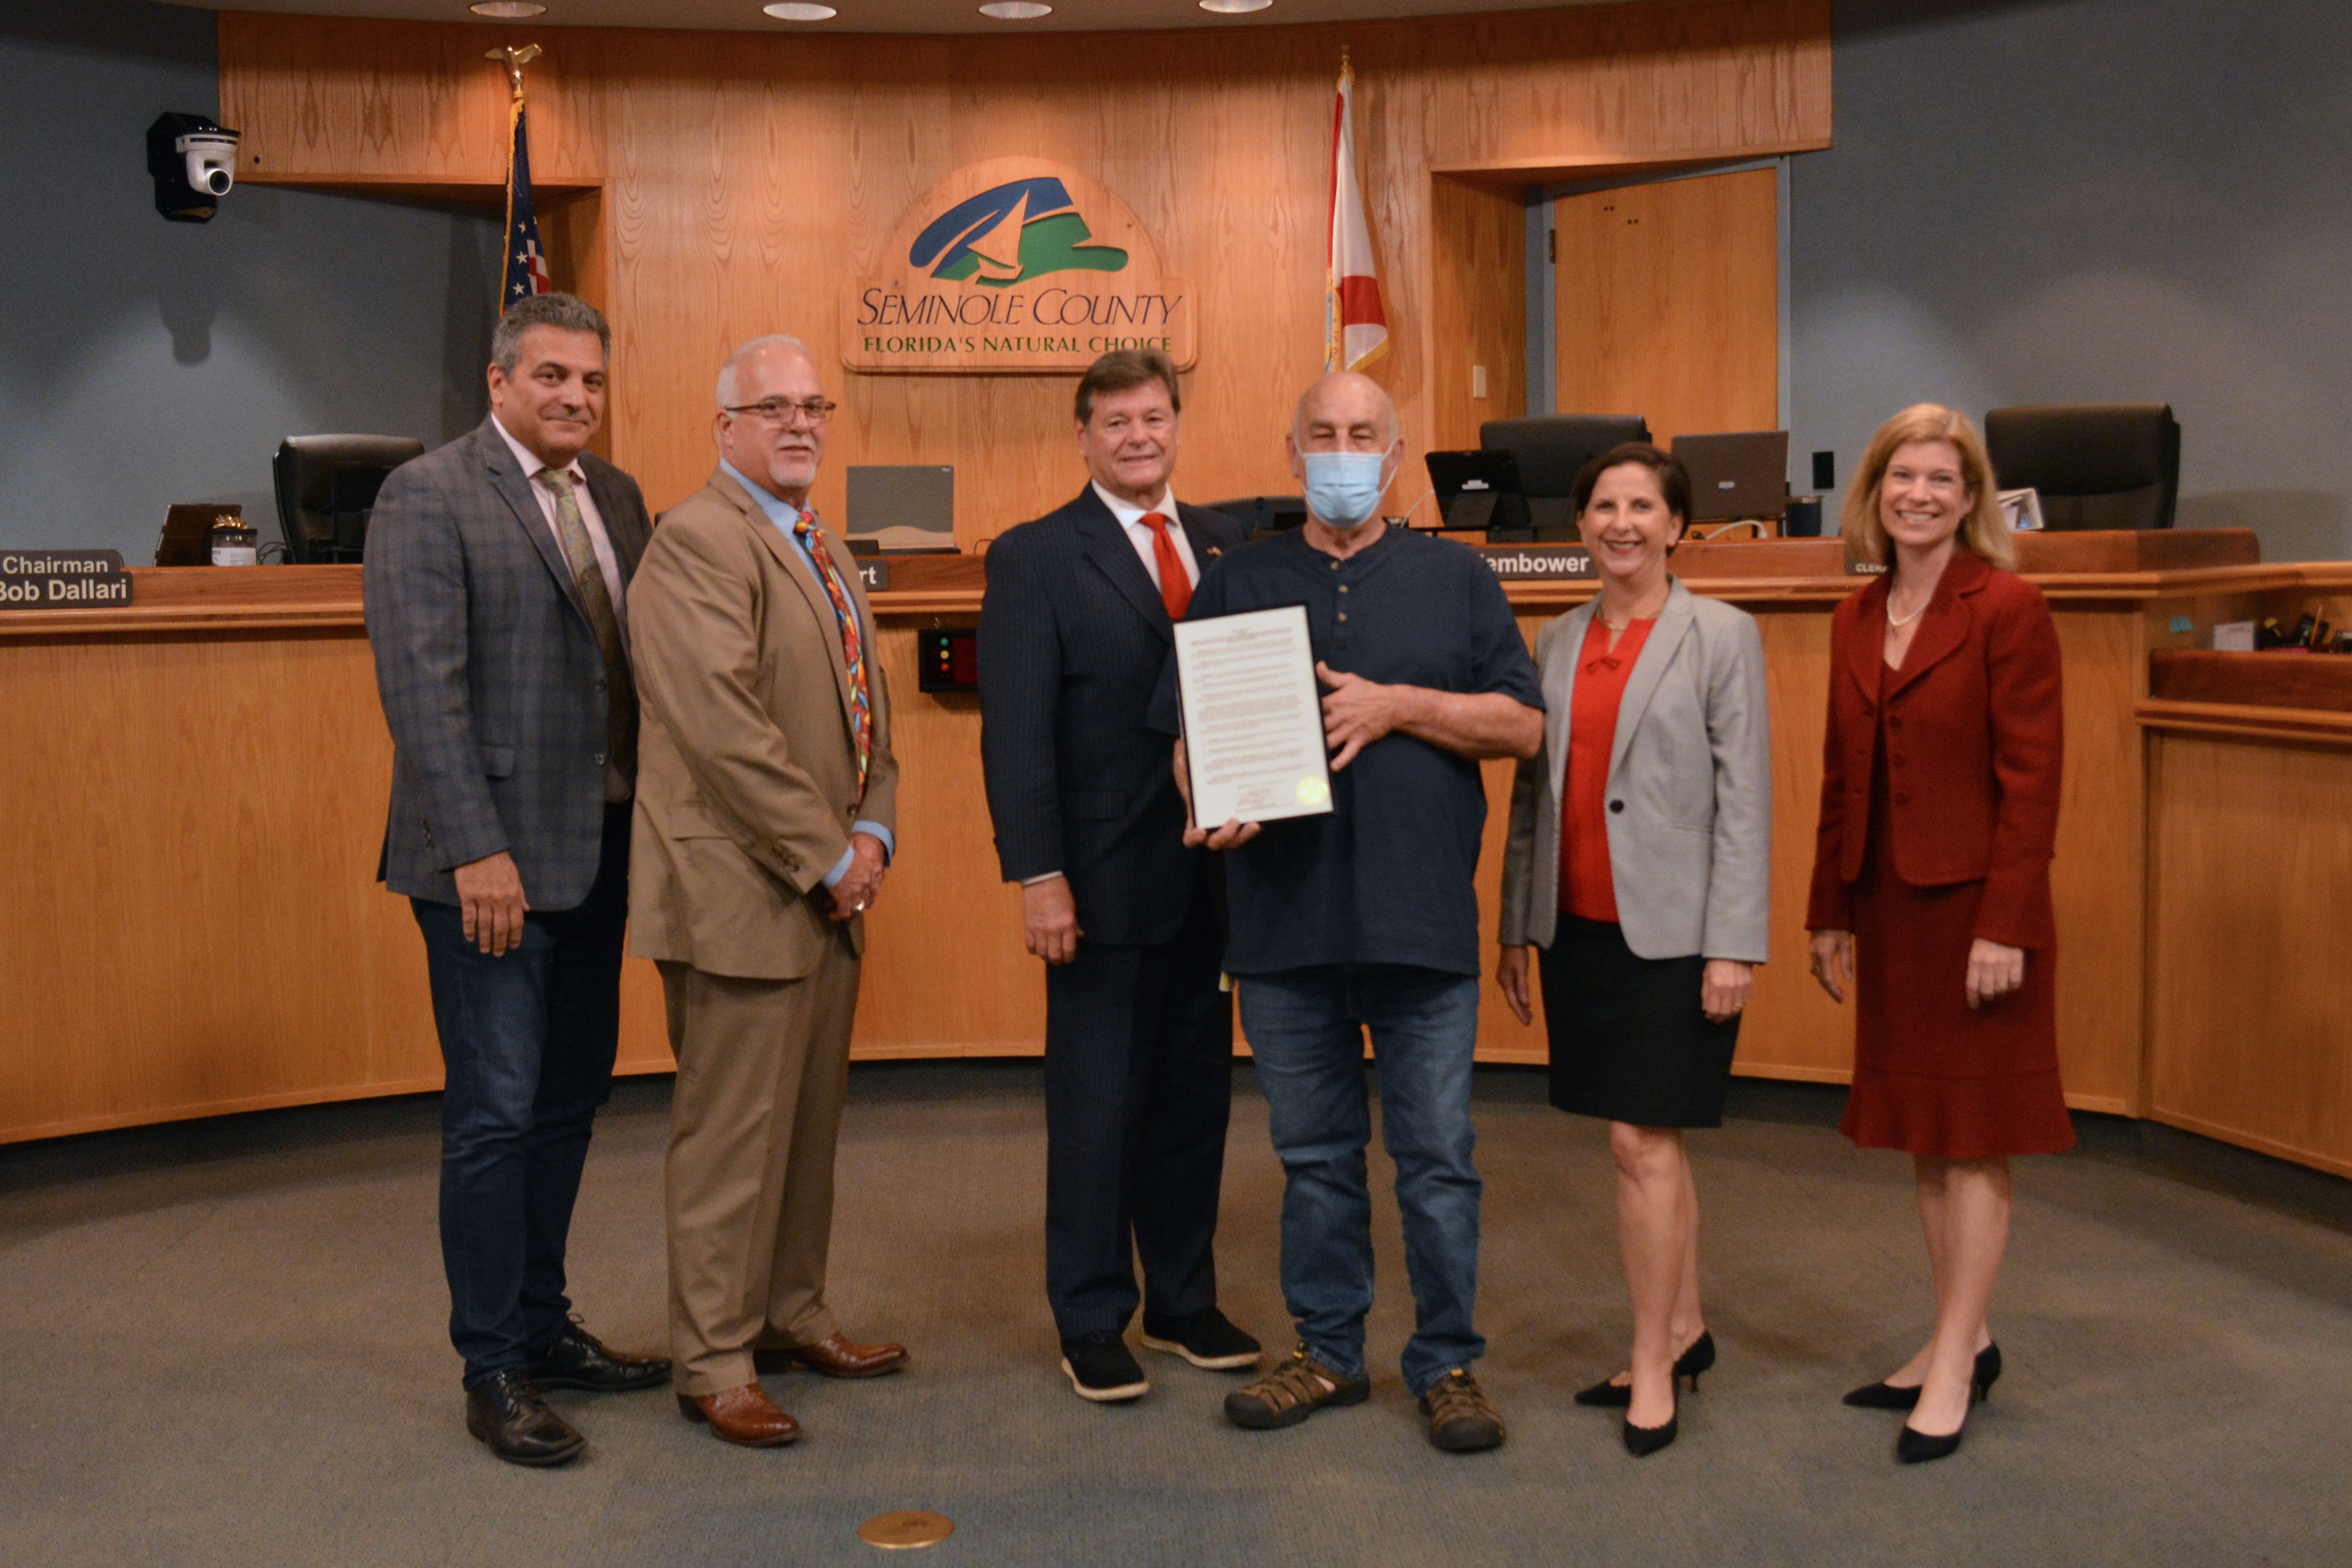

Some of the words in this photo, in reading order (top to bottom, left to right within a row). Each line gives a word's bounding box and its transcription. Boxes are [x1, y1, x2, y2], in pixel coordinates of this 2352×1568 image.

[857, 288, 1024, 325] SEMINOLE
[1033, 288, 1182, 325] COUNTY
[864, 337, 975, 353] FLORIDA'S
[983, 337, 1081, 353] NATURAL
[1089, 337, 1172, 353] CHOICE
[2, 556, 108, 574] Chairman
[1480, 553, 1590, 573] embower
[48, 578, 127, 601] Dallari
